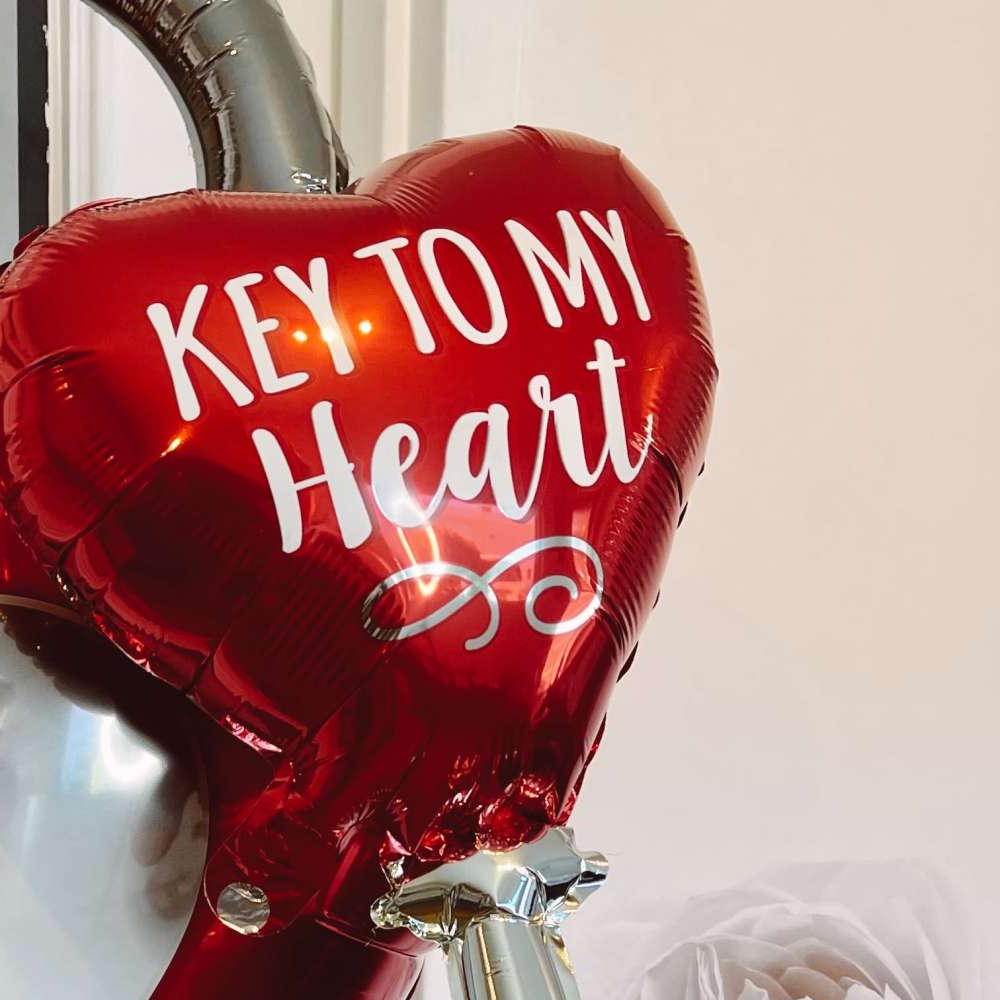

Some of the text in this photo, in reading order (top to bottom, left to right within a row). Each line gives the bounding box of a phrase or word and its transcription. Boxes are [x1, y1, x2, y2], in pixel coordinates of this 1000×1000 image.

[146, 209, 652, 422] KEY TO MY
[251, 338, 653, 553] Heart
